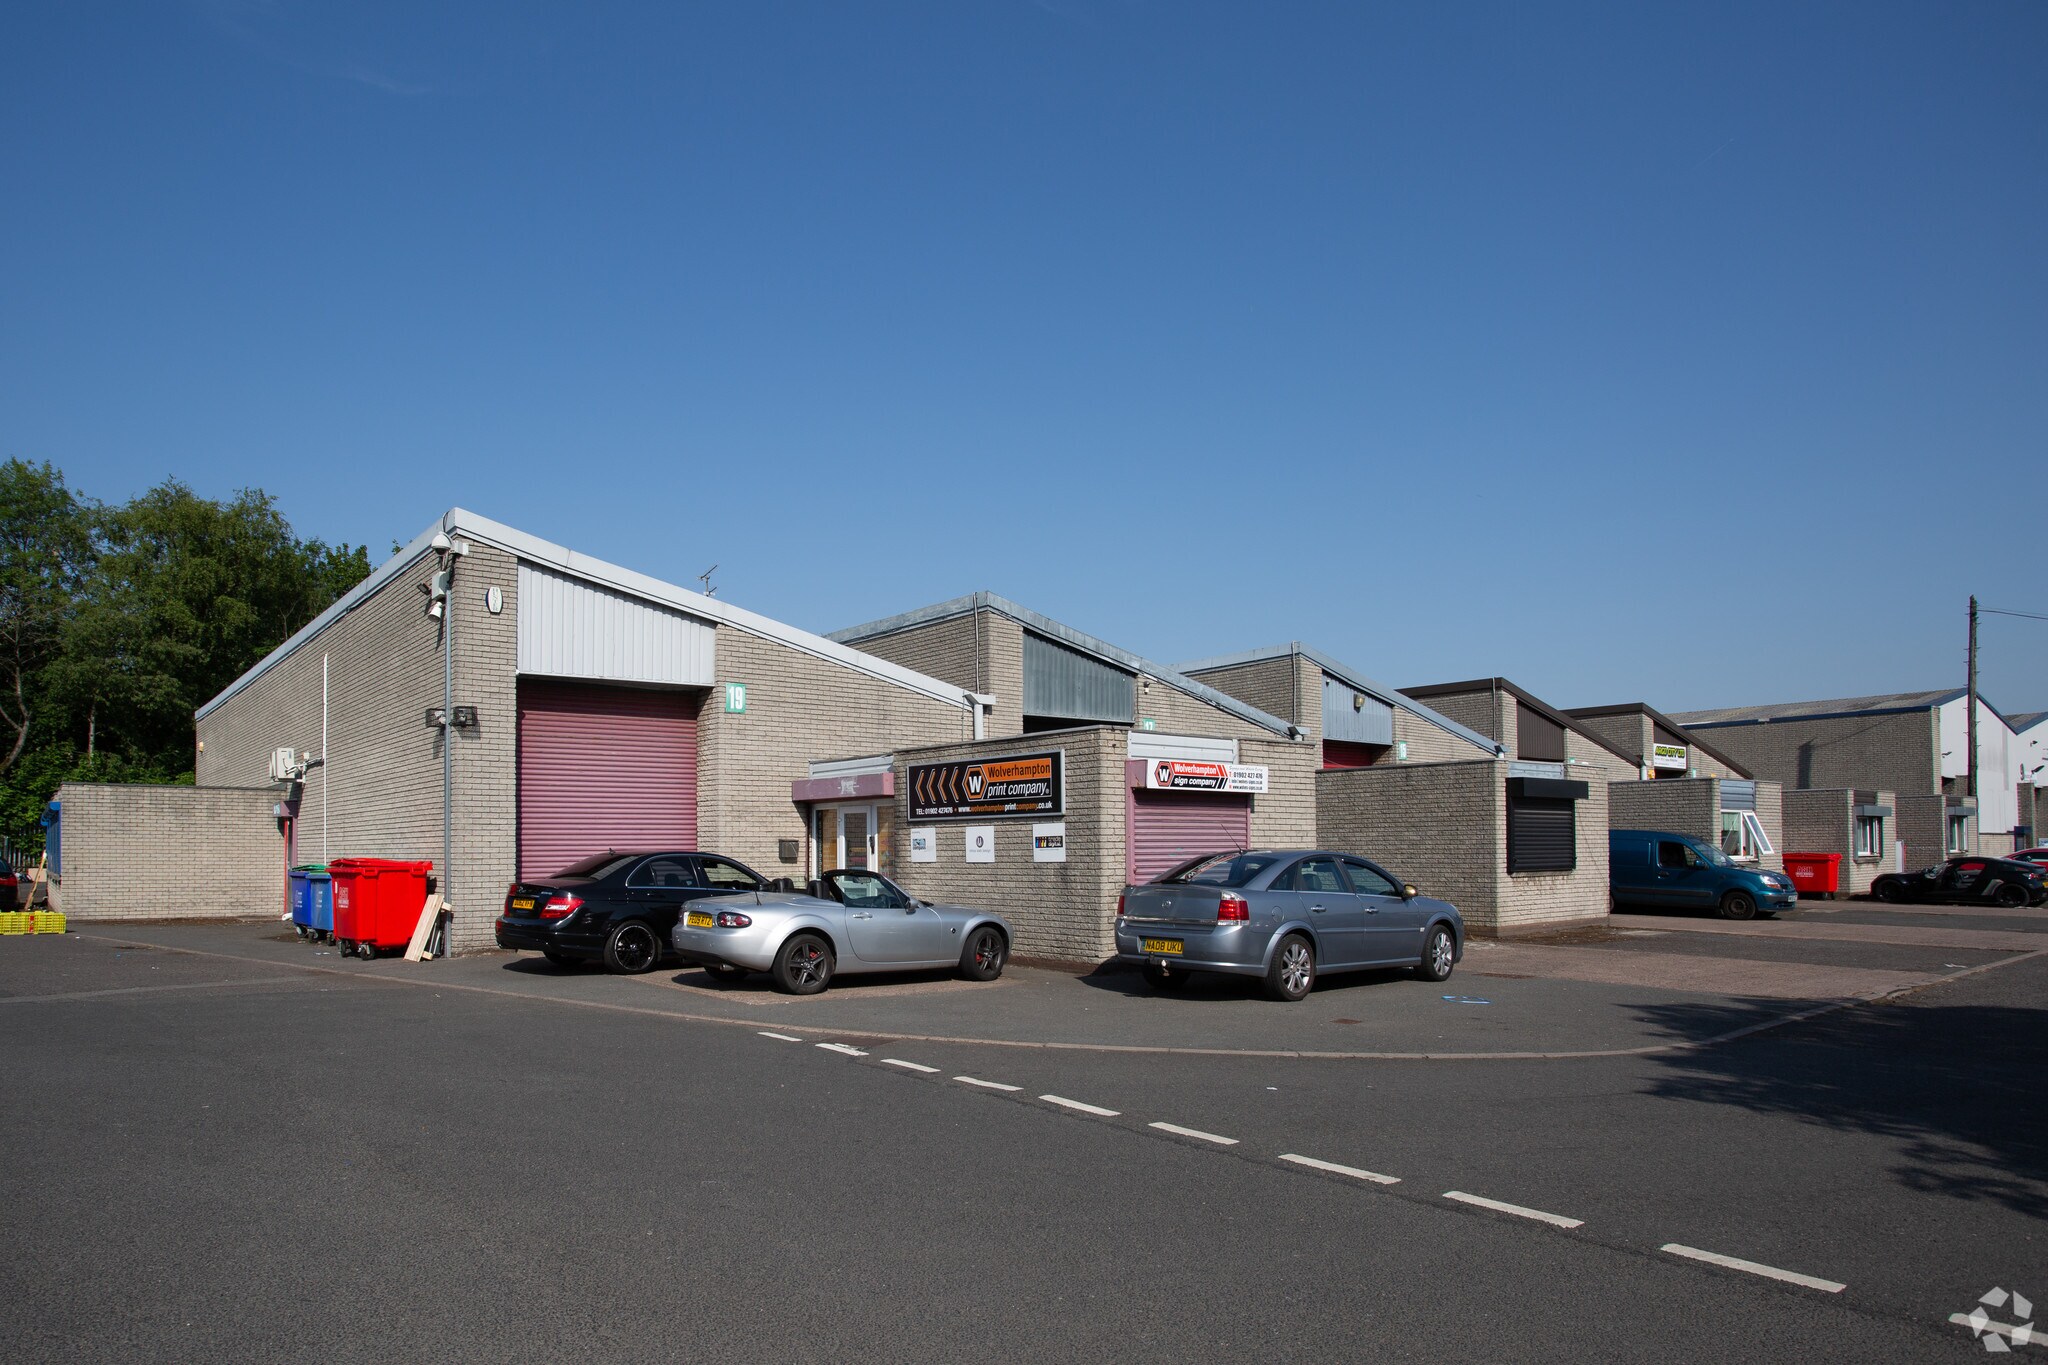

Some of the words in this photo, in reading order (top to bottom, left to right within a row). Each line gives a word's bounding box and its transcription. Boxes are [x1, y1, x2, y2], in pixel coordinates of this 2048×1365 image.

[730, 686, 743, 709] 19
[988, 763, 1051, 778] Wolverhampton
[1160, 768, 1169, 782] W
[1174, 763, 1217, 776] Wolverhampton
[969, 775, 982, 793] W
[1174, 777, 1188, 786] sign
[1189, 779, 1217, 787] company
[988, 784, 1007, 798] print
[1008, 782, 1048, 797] company
[958, 801, 1053, 813] www.wolverhamptonprintcompany.co.uk
[1146, 940, 1165, 950] NA08
[1167, 942, 1184, 952] UKU
